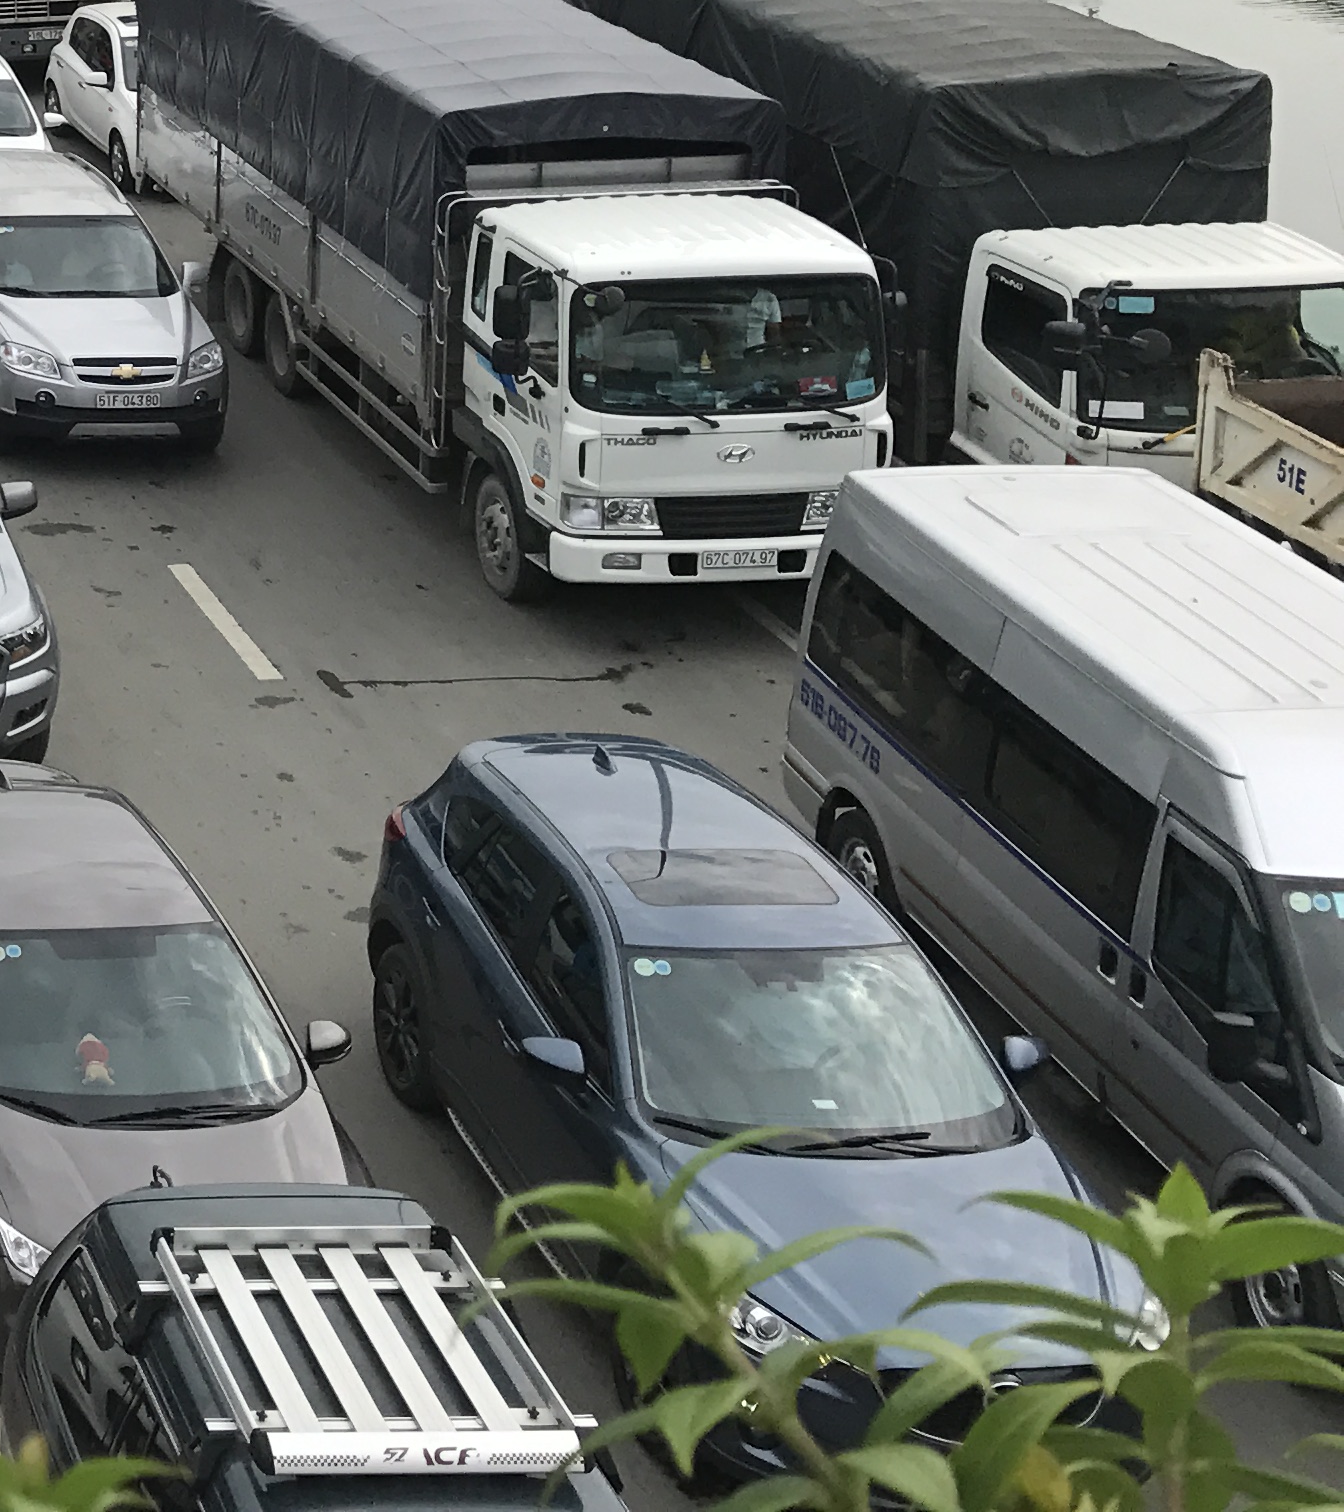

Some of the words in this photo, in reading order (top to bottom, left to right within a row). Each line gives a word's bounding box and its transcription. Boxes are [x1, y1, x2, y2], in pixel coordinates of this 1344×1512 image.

[1024, 397, 1061, 431] HINO
[605, 437, 658, 446] THACO
[798, 427, 864, 442] HYUNDAI
[1277, 457, 1307, 496] 51E
